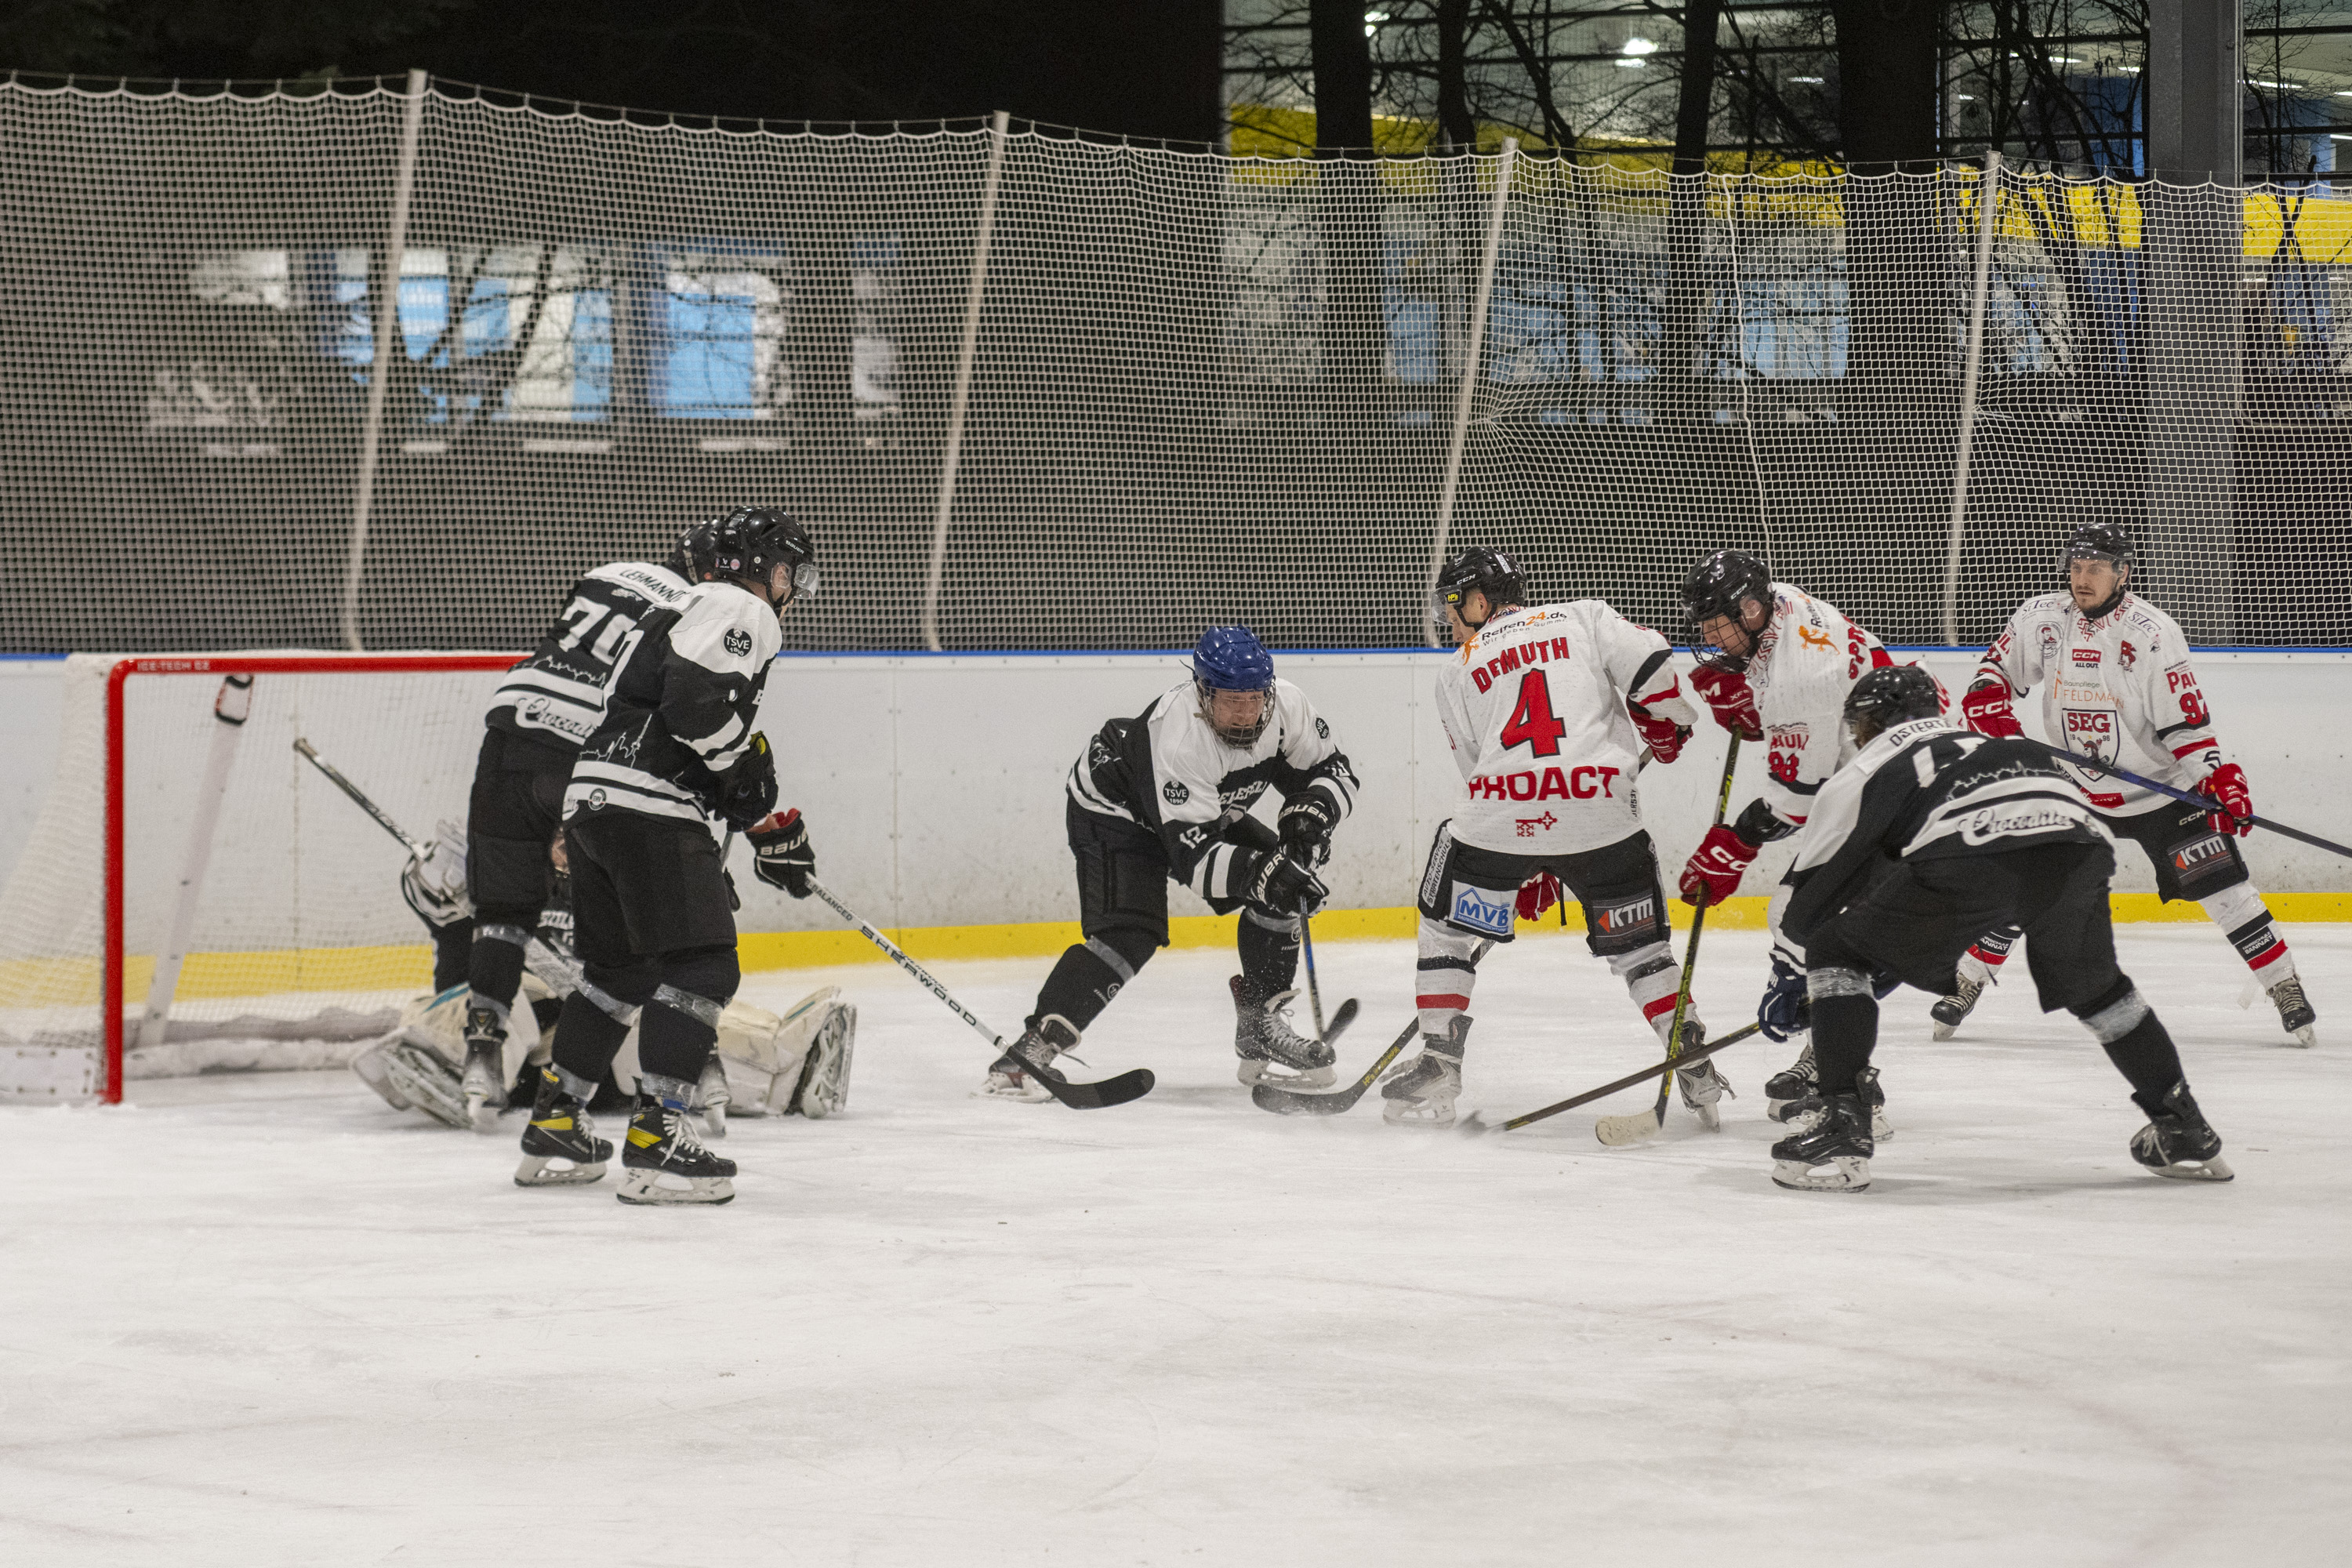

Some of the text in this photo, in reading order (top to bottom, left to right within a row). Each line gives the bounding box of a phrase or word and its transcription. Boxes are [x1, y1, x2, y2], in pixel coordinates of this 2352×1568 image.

[619, 569, 676, 602] LEHMANN
[1457, 574, 1476, 585] CCM
[1730, 583, 1748, 600] CCM
[2129, 612, 2157, 633] SiTec
[726, 635, 750, 650] TSVE
[1483, 637, 1497, 646] Wir
[1502, 627, 1530, 639] geben
[1471, 637, 1570, 695] DEMUTH
[1501, 668, 1566, 759] 4
[2067, 712, 2111, 733] SEG
[1164, 787, 1188, 798] TSVE
[1468, 765, 1620, 801] PROACT
[2180, 809, 2206, 826] CCM
[1179, 826, 1207, 849] 12
[2180, 836, 2226, 866] KTM
[1460, 899, 1508, 927] MVB
[1608, 898, 1653, 928] KTM
[2245, 935, 2273, 955] BANNAT
[862, 925, 977, 1026] SHERWOOD
